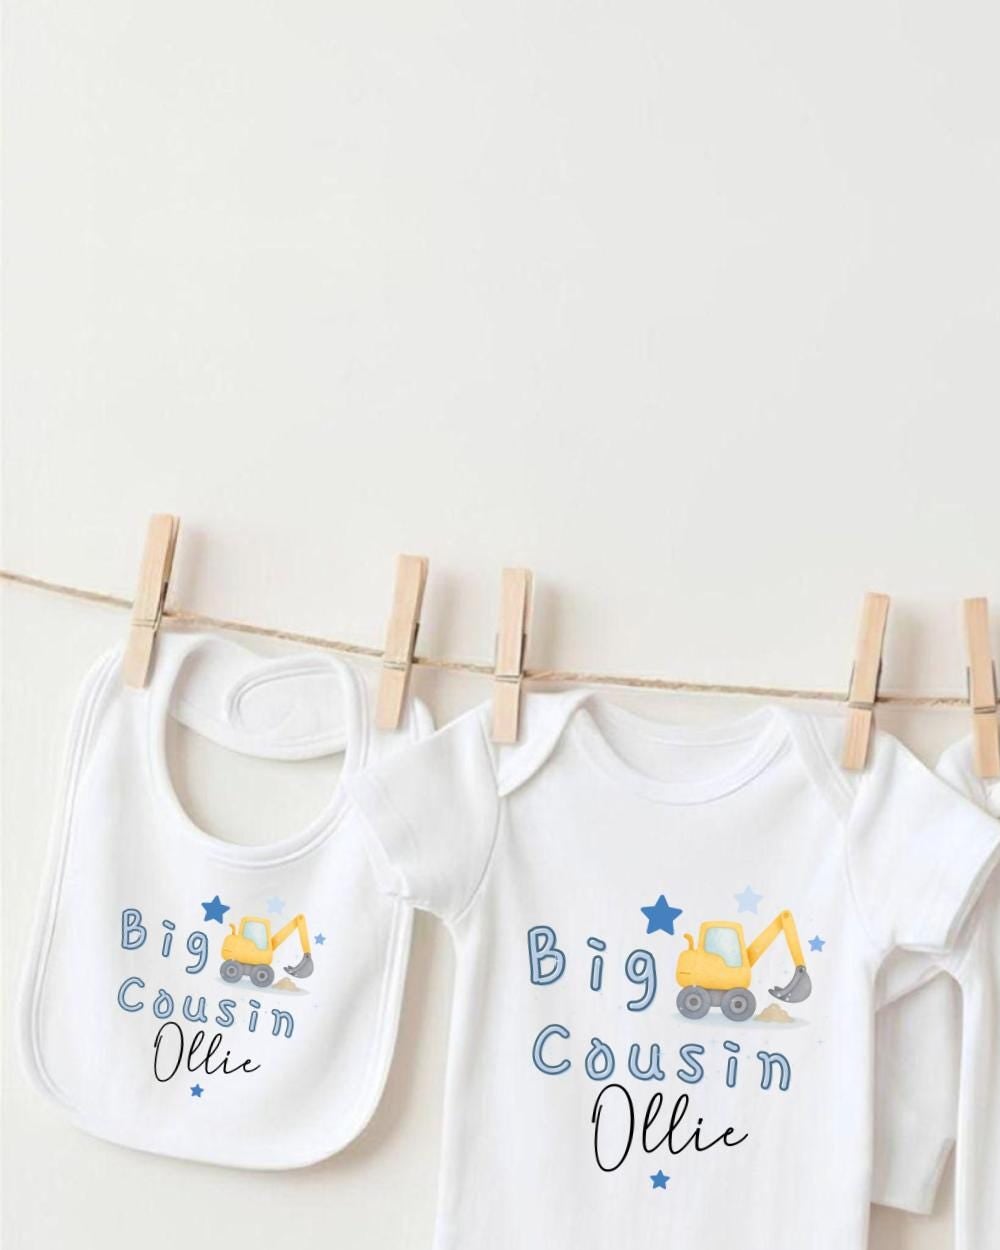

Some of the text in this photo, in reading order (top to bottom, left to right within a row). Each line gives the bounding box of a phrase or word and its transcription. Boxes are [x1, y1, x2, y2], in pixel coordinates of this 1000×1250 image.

[120, 908, 208, 974] Big
[528, 926, 656, 1011] Big
[117, 977, 294, 1038] Cousin
[154, 1022, 260, 1082] Ollie
[533, 1025, 790, 1091] Cousin
[592, 1084, 748, 1172] Ollie
